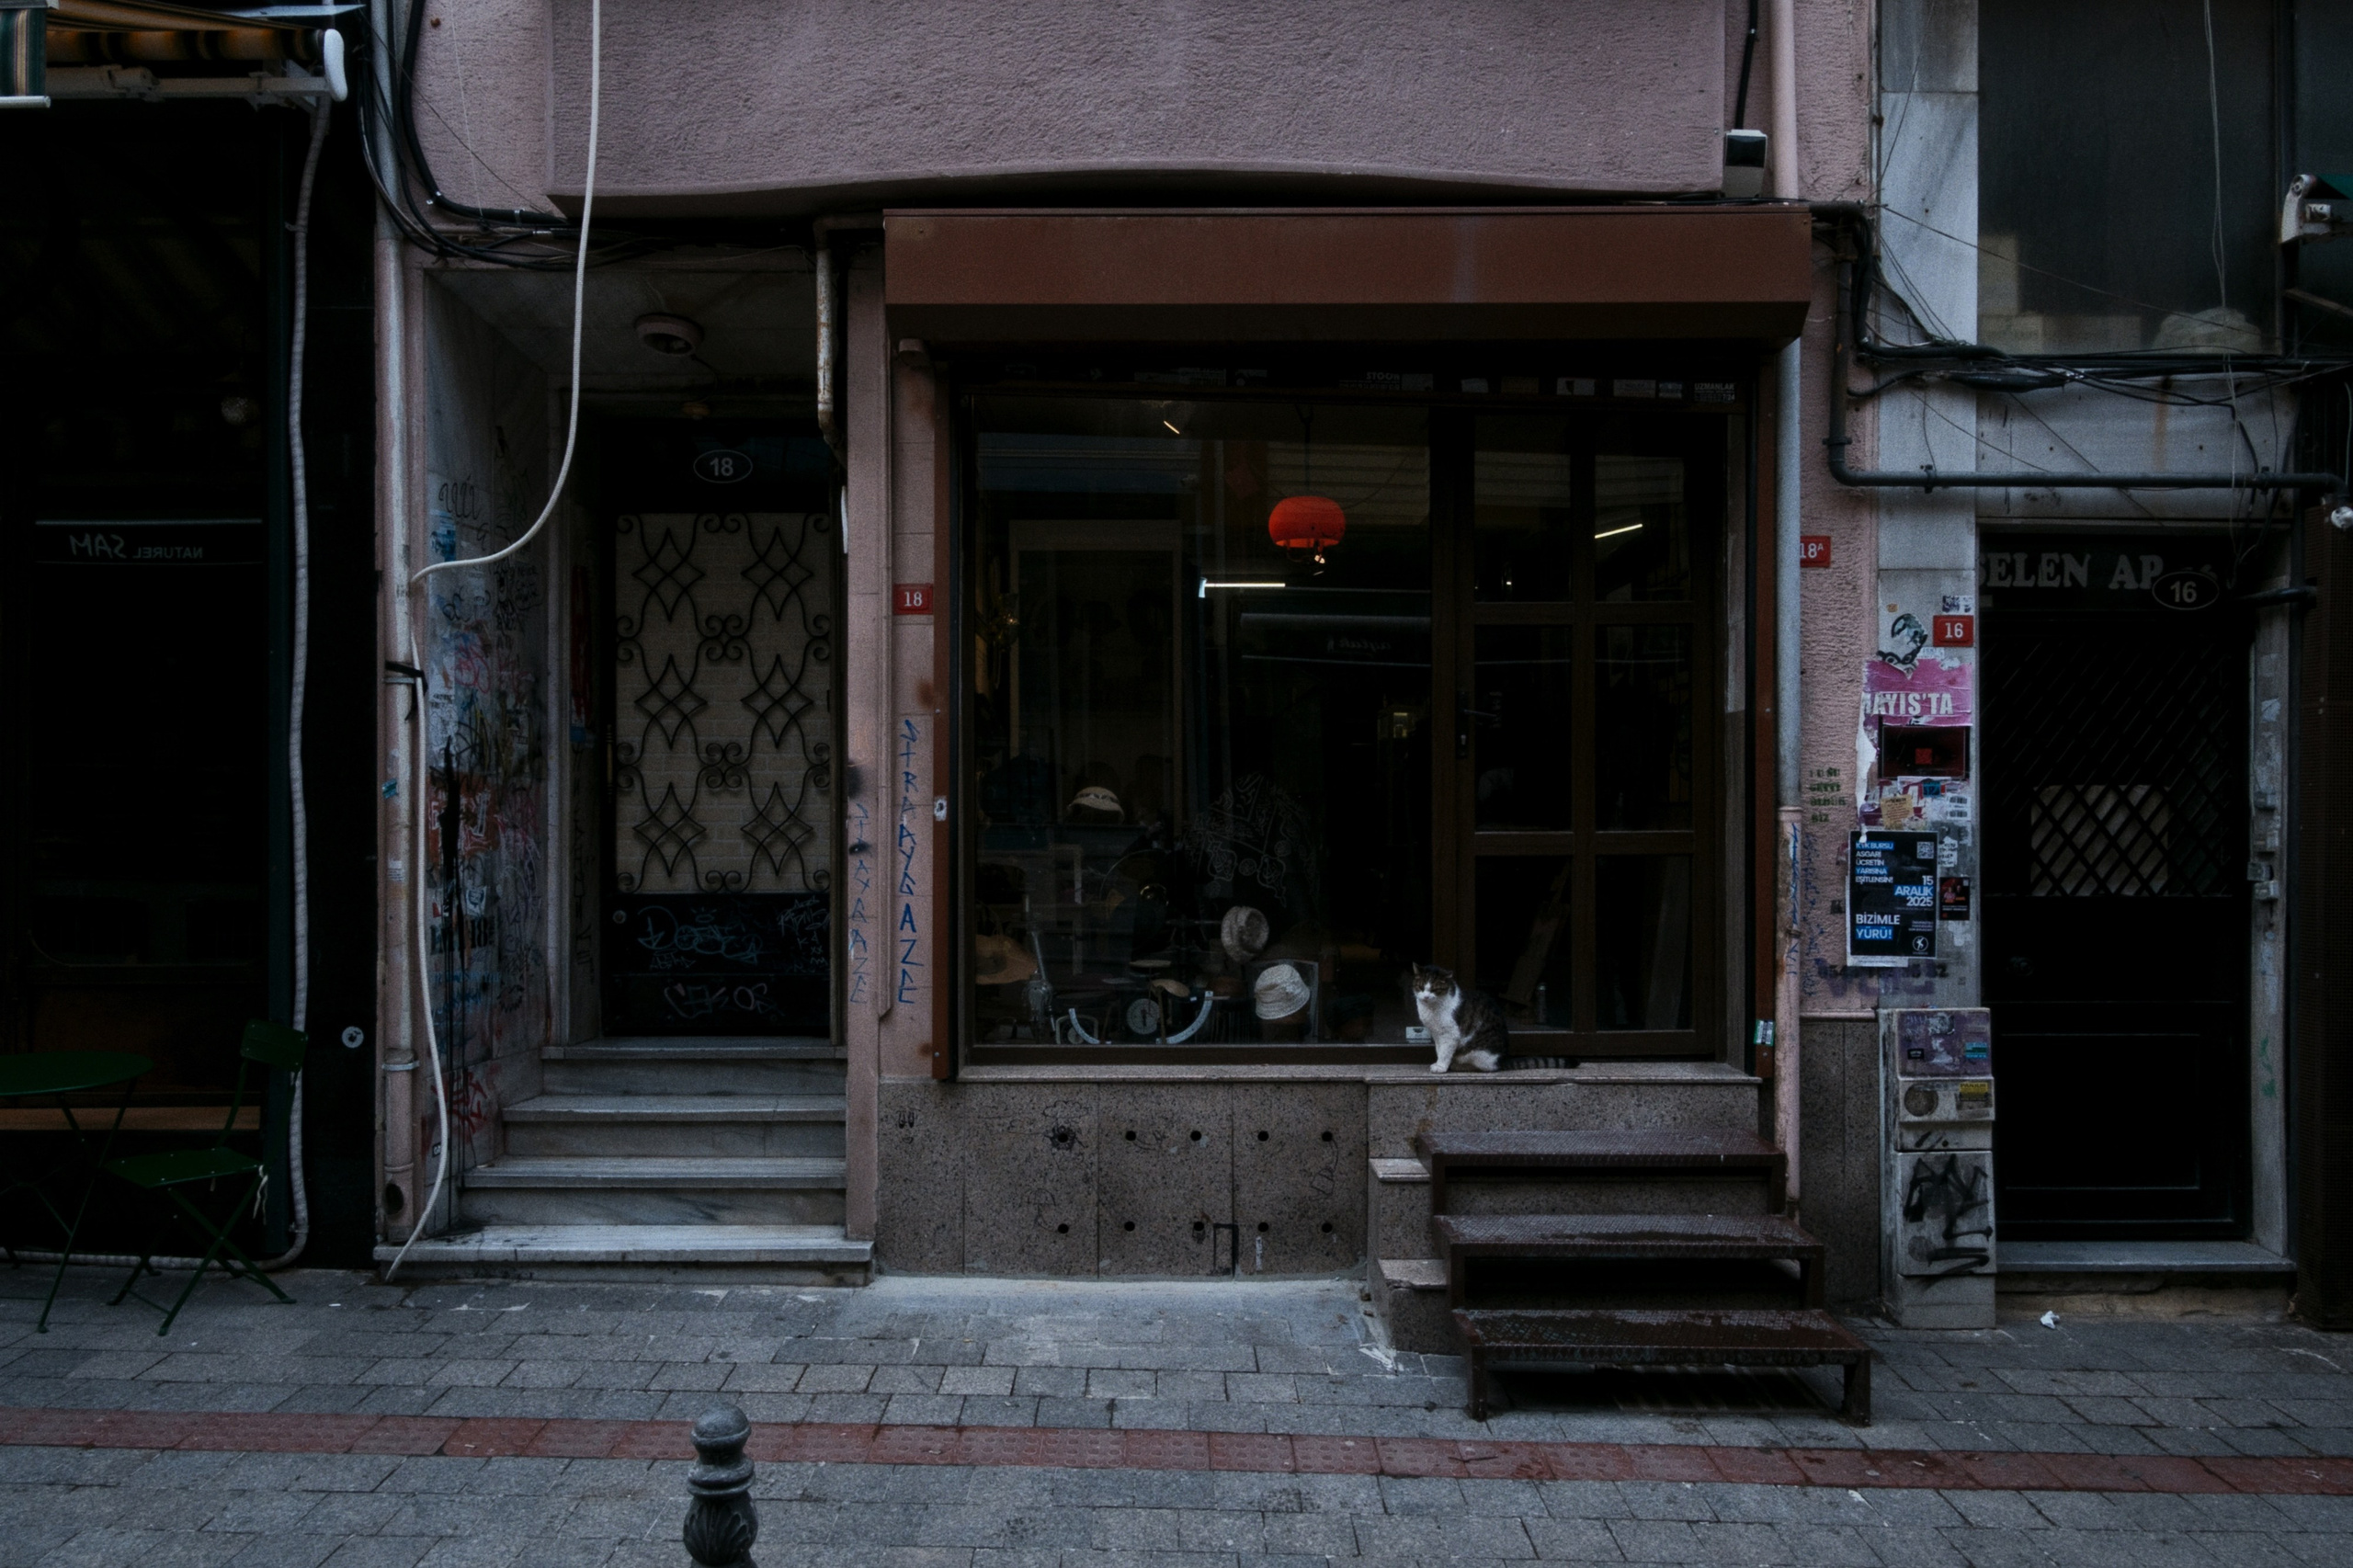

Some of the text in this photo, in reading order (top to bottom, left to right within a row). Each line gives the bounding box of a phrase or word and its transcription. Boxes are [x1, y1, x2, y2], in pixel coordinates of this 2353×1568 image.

[709, 456, 734, 478] 18
[2108, 553, 2165, 590] AP
[904, 591, 924, 608] 18
[2168, 580, 2199, 604] 16
[1944, 621, 1964, 640] 16
[1922, 875, 1934, 886] 15
[1894, 886, 1934, 896] ARALIK
[1906, 896, 1934, 907] 2025
[1855, 912, 1901, 925] BİZİMLE
[1856, 926, 1893, 939] YÜRÜ!
